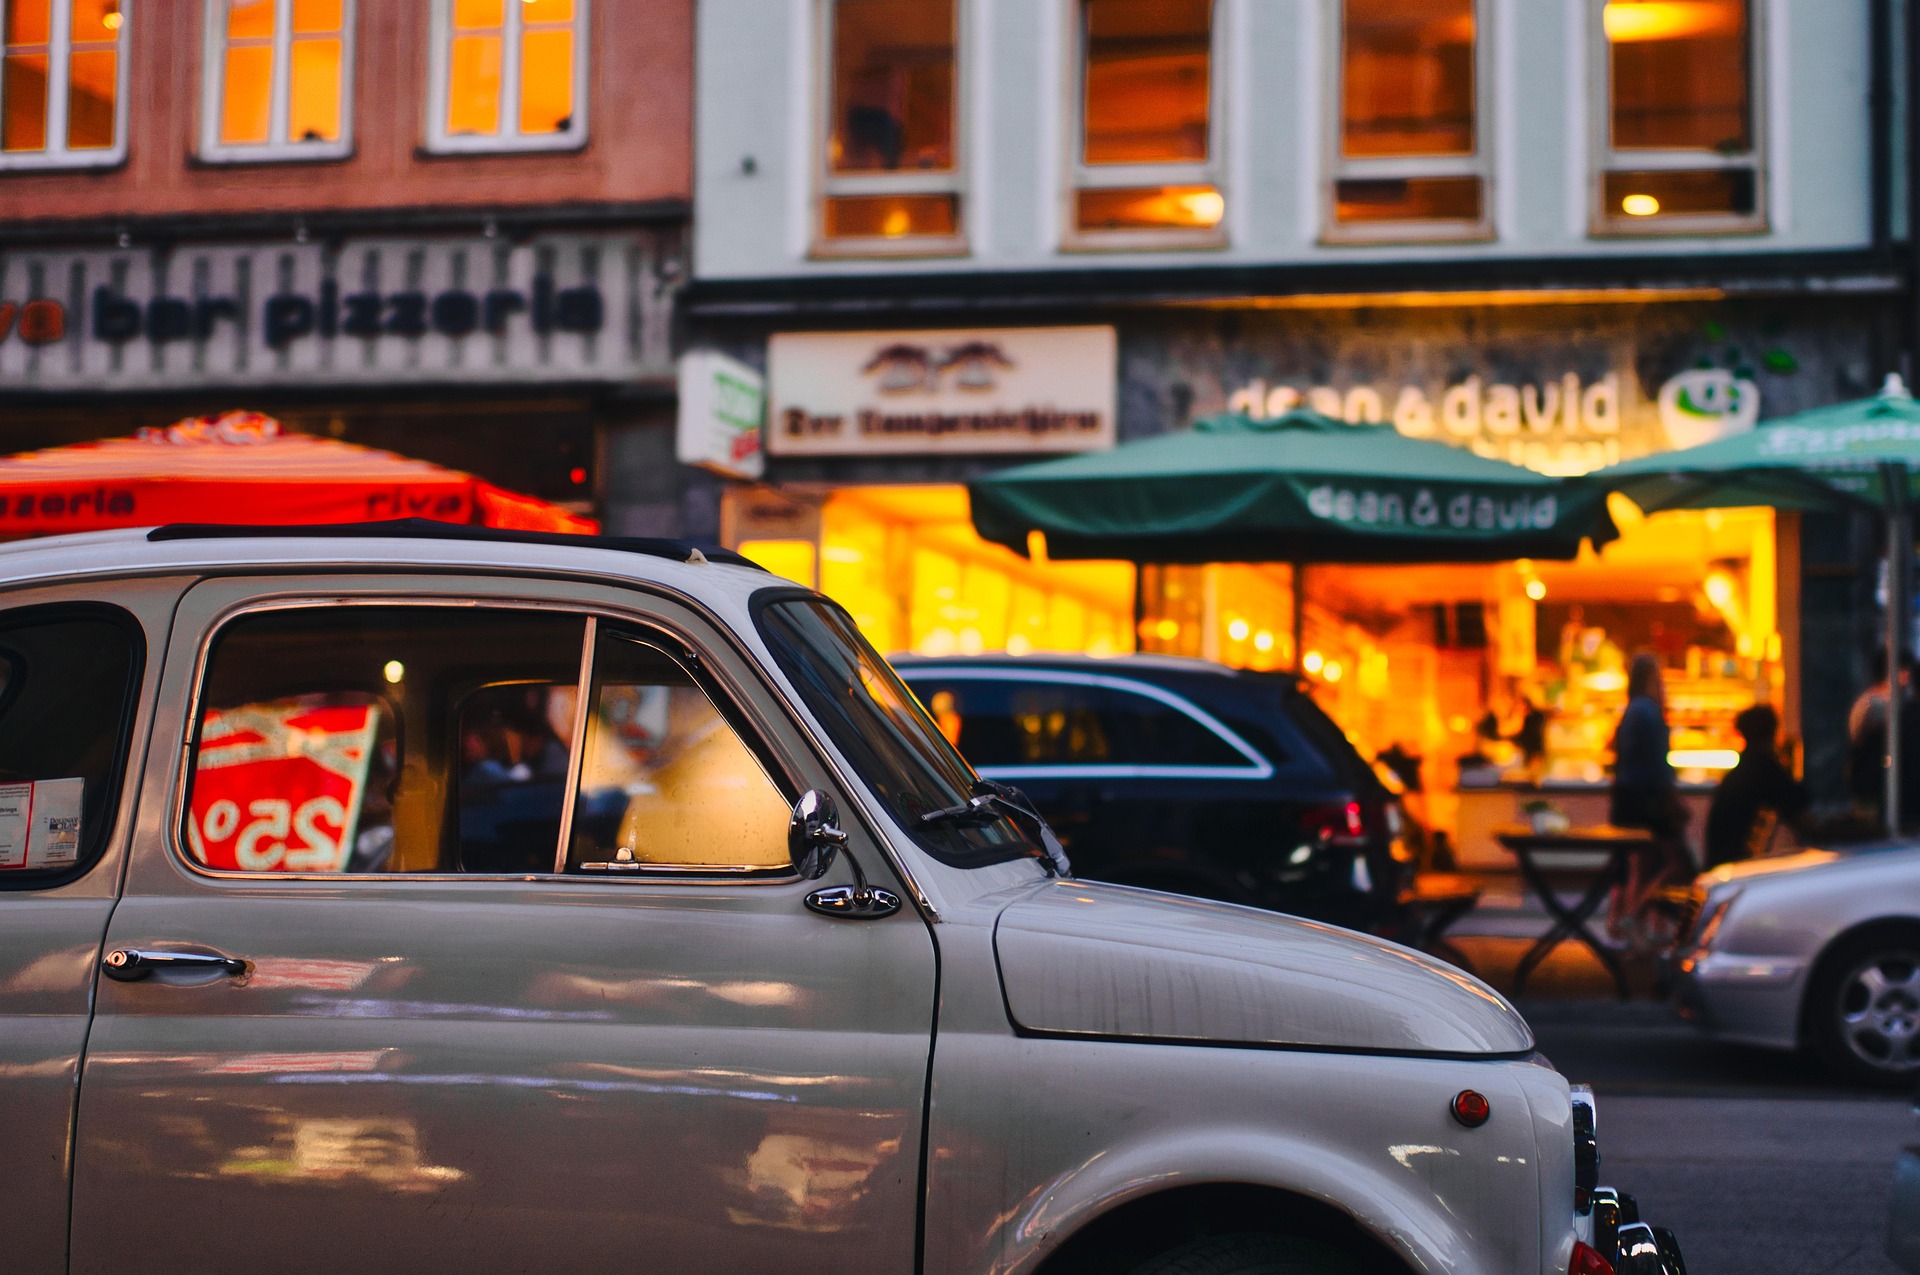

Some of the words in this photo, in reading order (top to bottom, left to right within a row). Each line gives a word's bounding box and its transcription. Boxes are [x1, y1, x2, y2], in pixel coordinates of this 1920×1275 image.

[94, 284, 236, 342] bar
[264, 276, 602, 347] pizzeria
[1229, 376, 1383, 425] dean
[1393, 385, 1436, 438] &
[1442, 371, 1621, 436] david
[366, 484, 463, 519] riva
[1308, 485, 1402, 522] dean
[1410, 489, 1440, 527] &
[1448, 494, 1558, 530] david
